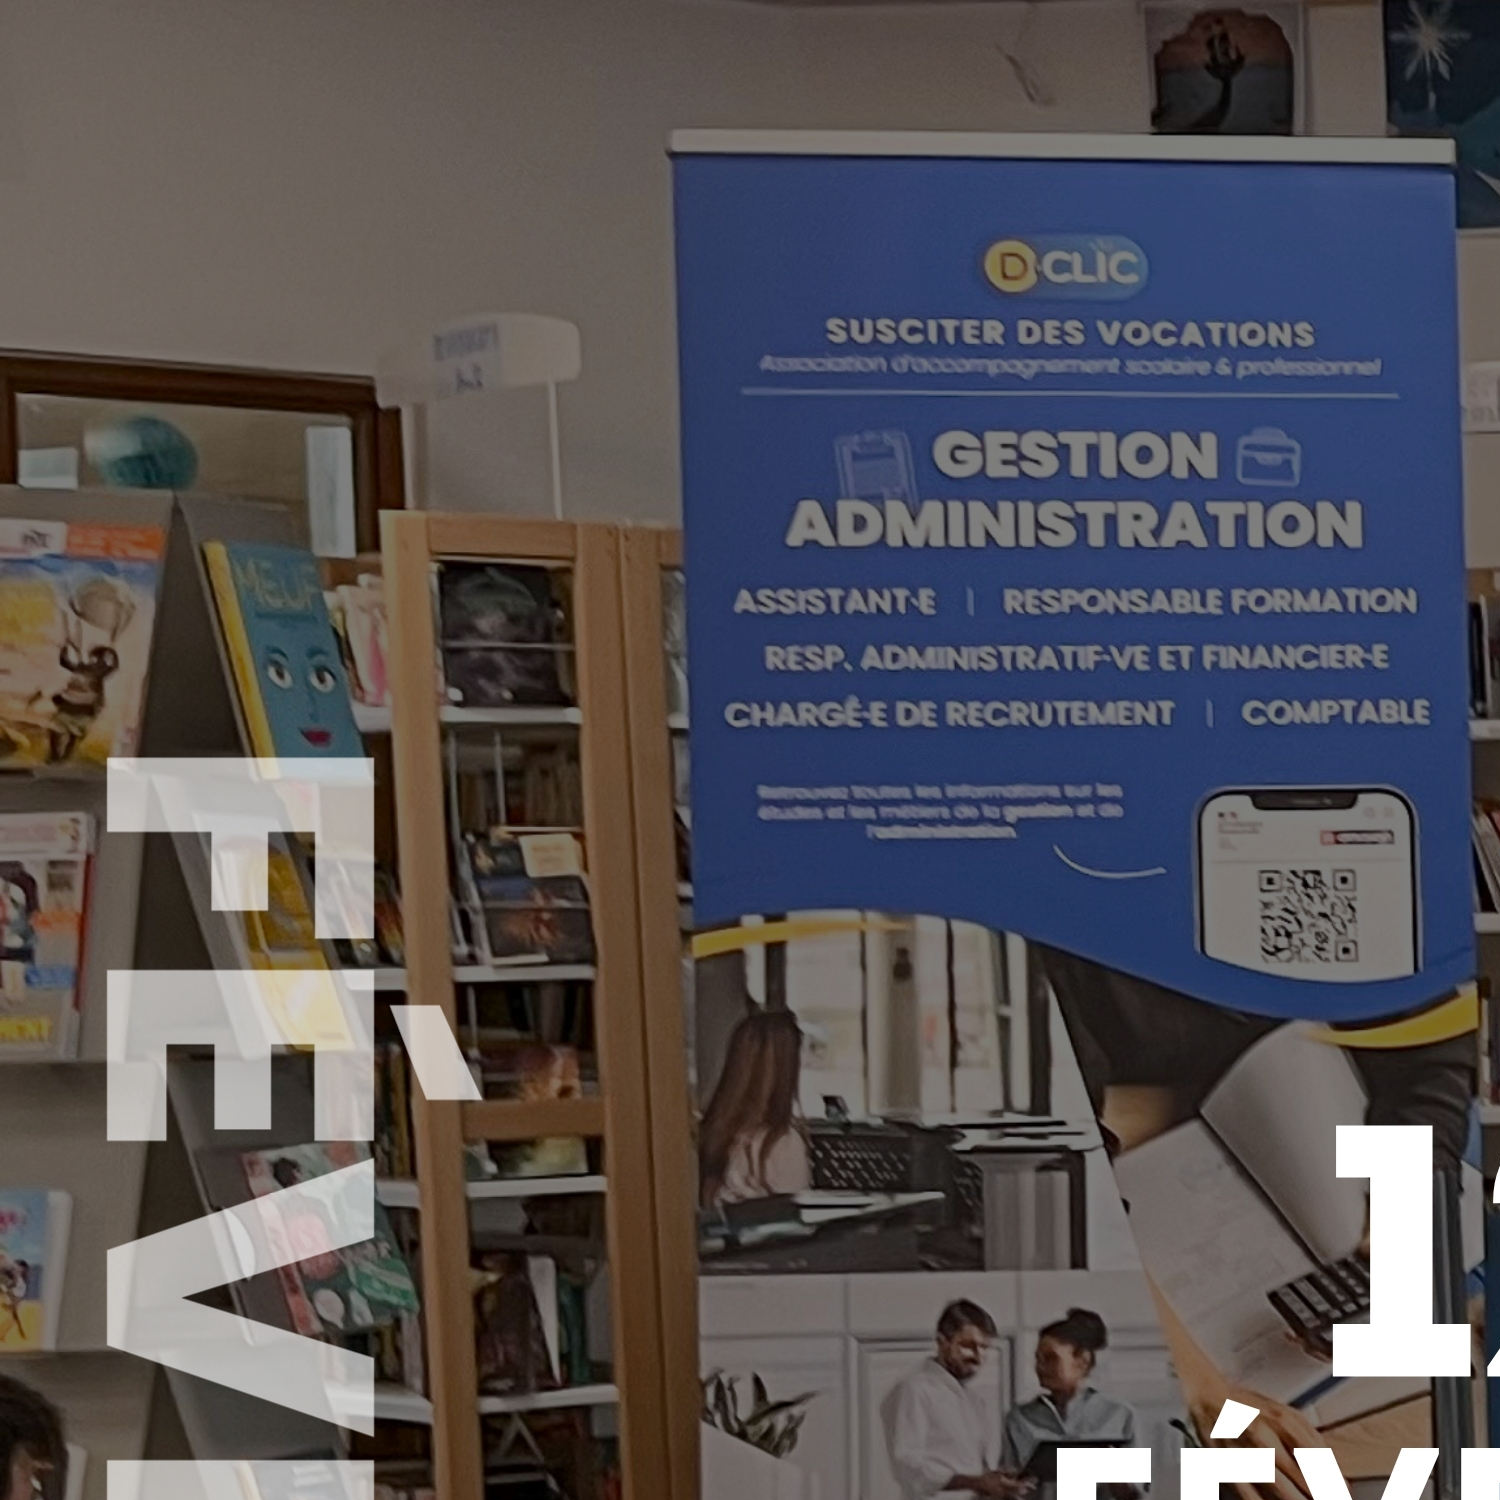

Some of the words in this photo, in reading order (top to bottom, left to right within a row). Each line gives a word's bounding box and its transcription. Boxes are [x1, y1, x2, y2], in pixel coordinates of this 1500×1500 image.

[825, 317, 1005, 345] SUSCITER
[1017, 318, 1085, 345] DES
[1096, 319, 1316, 348] VOCATIONS
[932, 430, 1219, 480] GESTION
[785, 500, 1365, 550] ADMINISTRATION
[1002, 587, 1225, 616] RESPONSABLE
[1230, 587, 1419, 615] FORMATION
[763, 644, 854, 673] RESP.
[1157, 644, 1196, 672] ET
[895, 702, 939, 728] DE
[945, 700, 1178, 729] RECRUTEMENT
[1240, 698, 1433, 728] COMPTABLE
